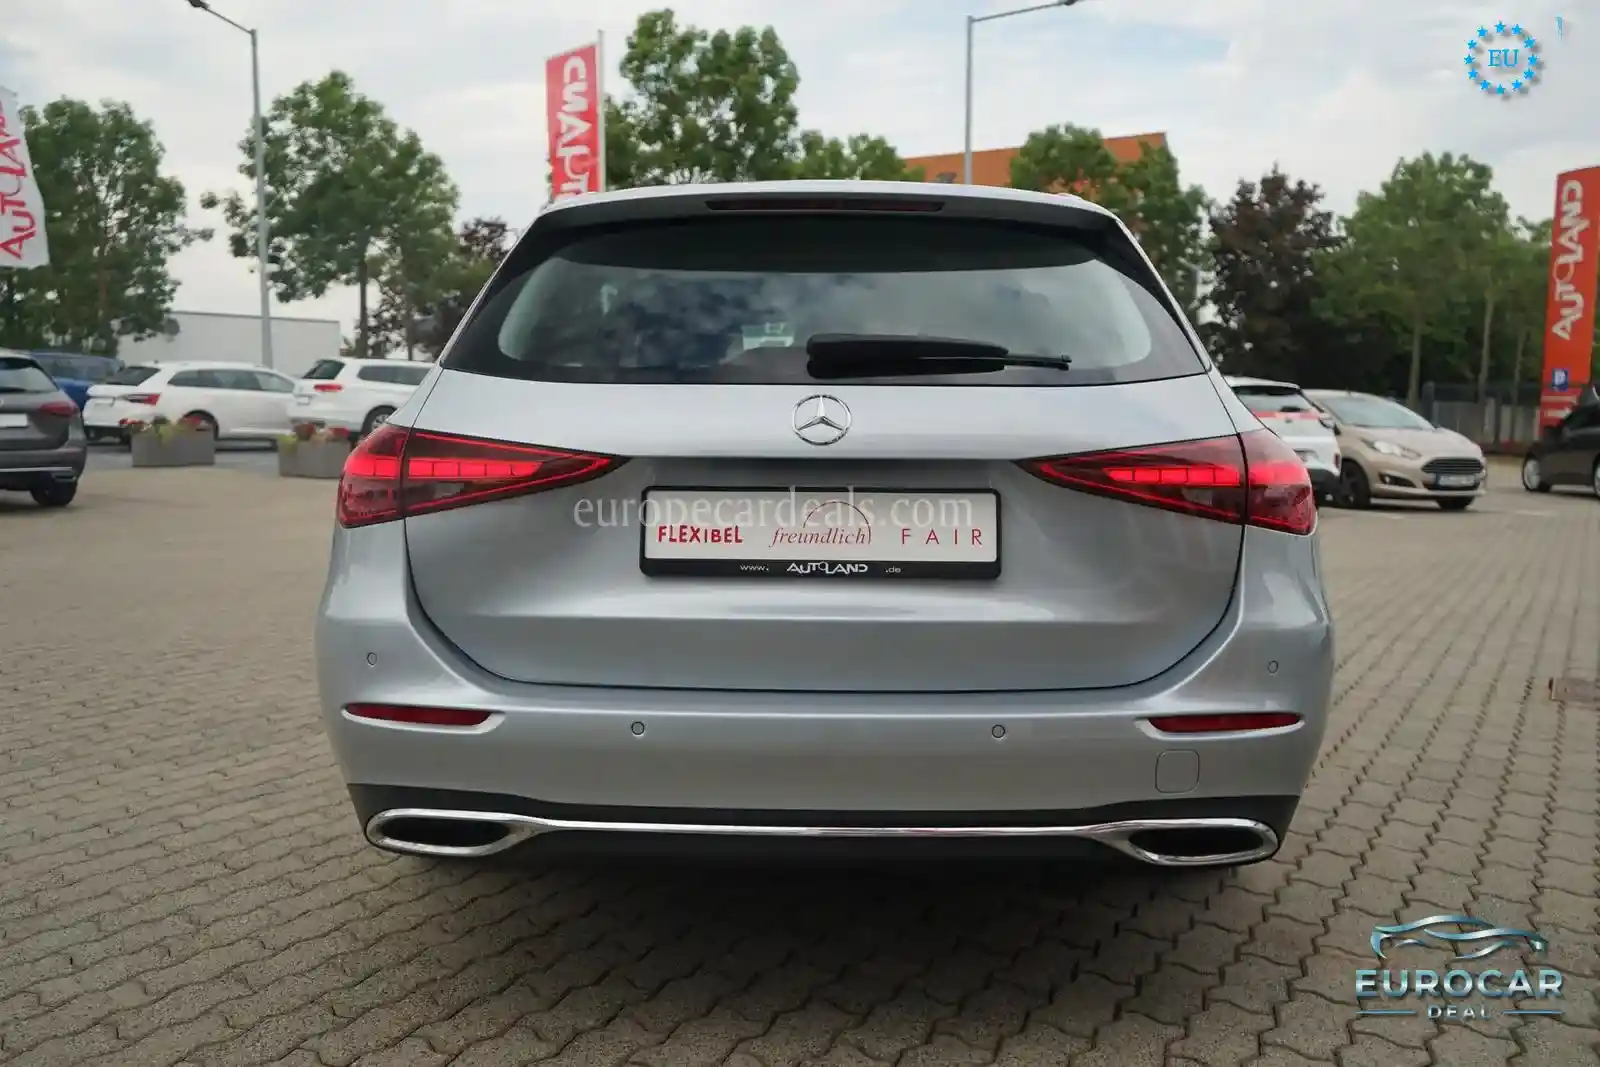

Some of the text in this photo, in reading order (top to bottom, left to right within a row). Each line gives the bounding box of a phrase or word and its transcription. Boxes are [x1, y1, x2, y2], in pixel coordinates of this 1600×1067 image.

[1552, 179, 1590, 340] AUTOLAND
[658, 525, 743, 544] FLEXIBEL
[768, 527, 866, 550] freundlich
[787, 561, 869, 575] AUTOLAND
